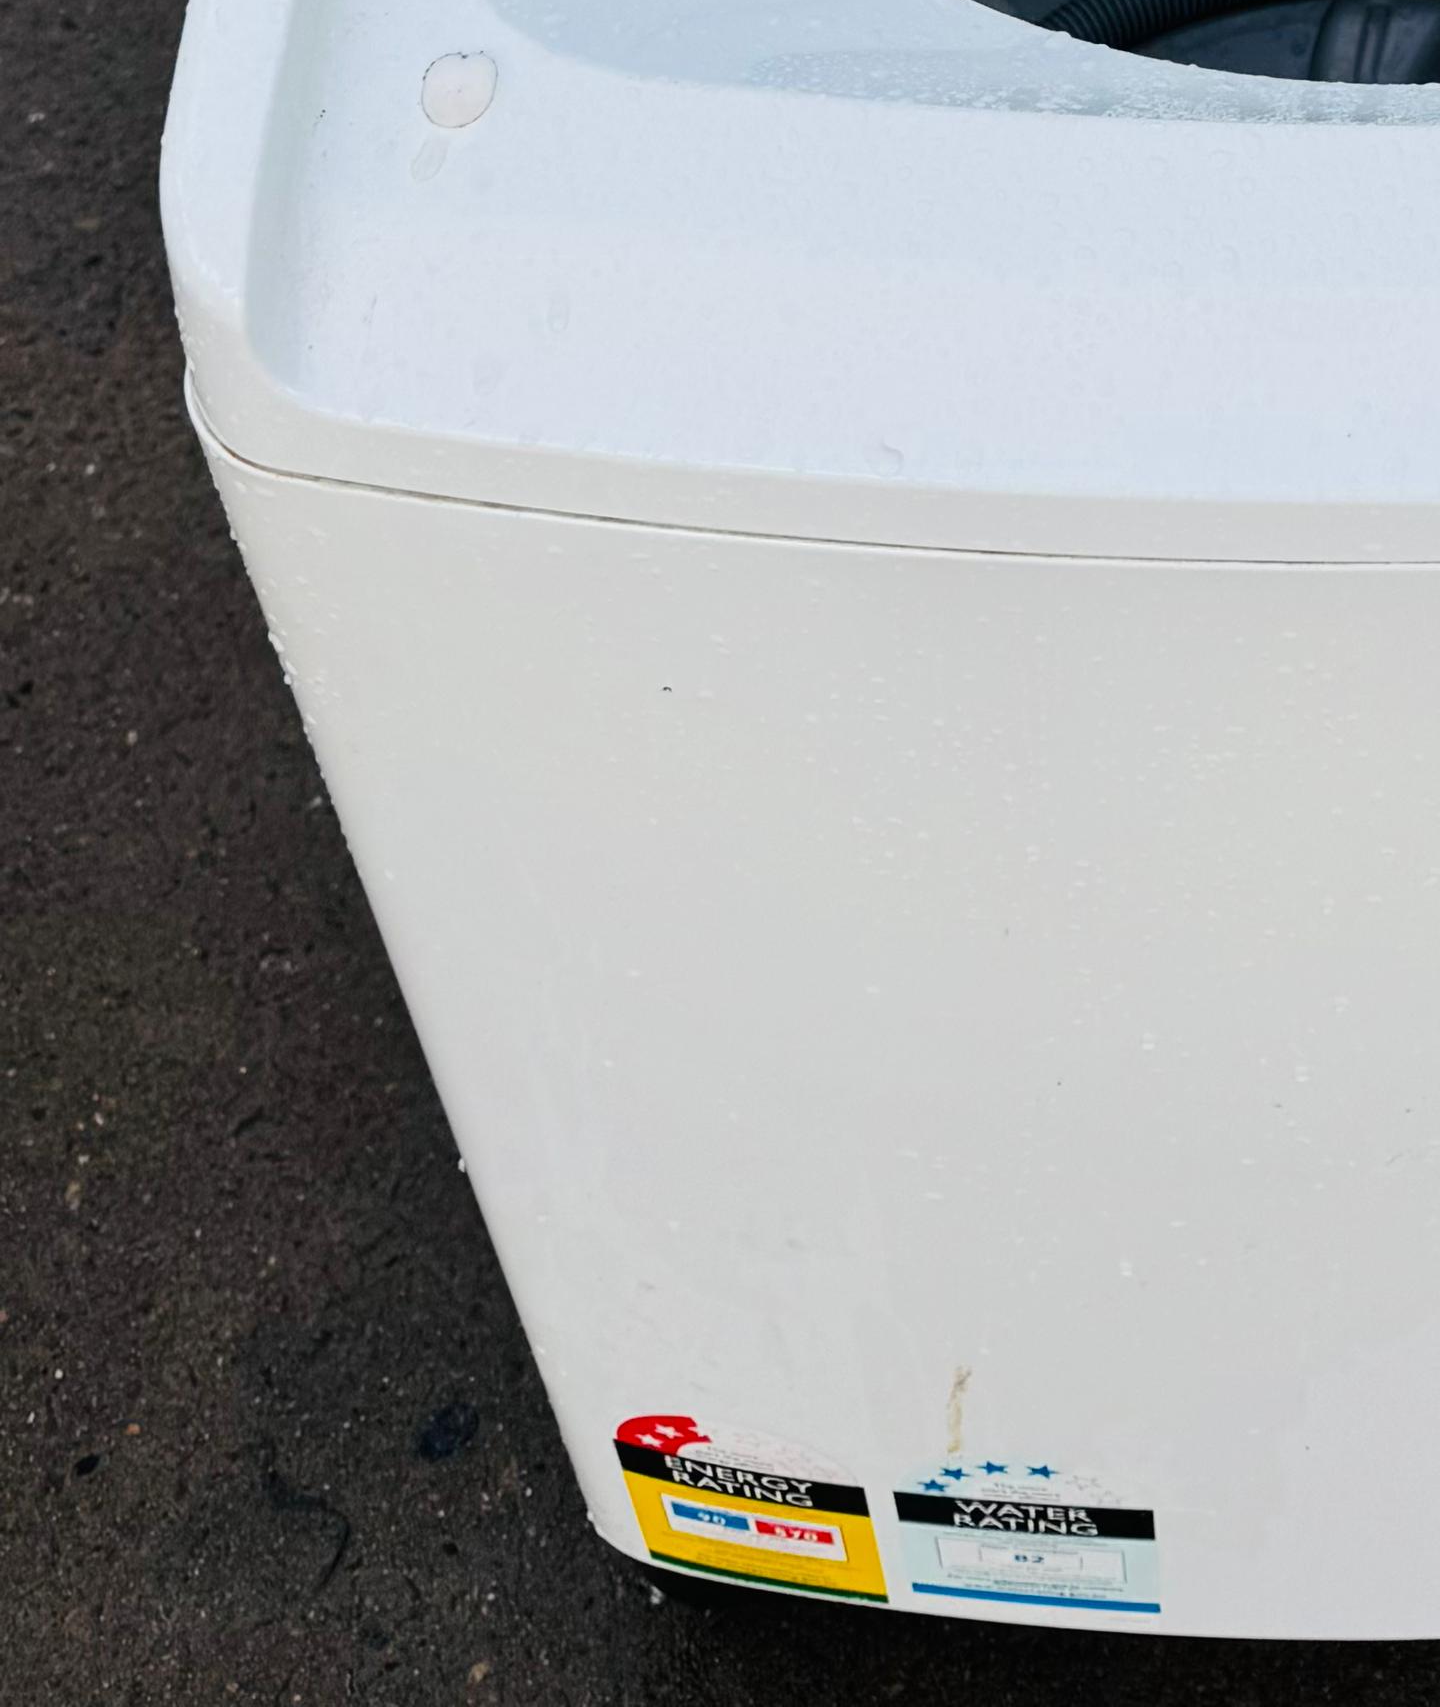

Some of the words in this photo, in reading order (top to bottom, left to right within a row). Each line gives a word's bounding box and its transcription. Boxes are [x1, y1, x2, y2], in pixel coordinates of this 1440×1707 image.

[663, 1454, 814, 1495] ENERGY
[673, 1470, 814, 1508] RATING
[952, 1513, 1099, 1537] RATING
[953, 1499, 1092, 1524] WATER
